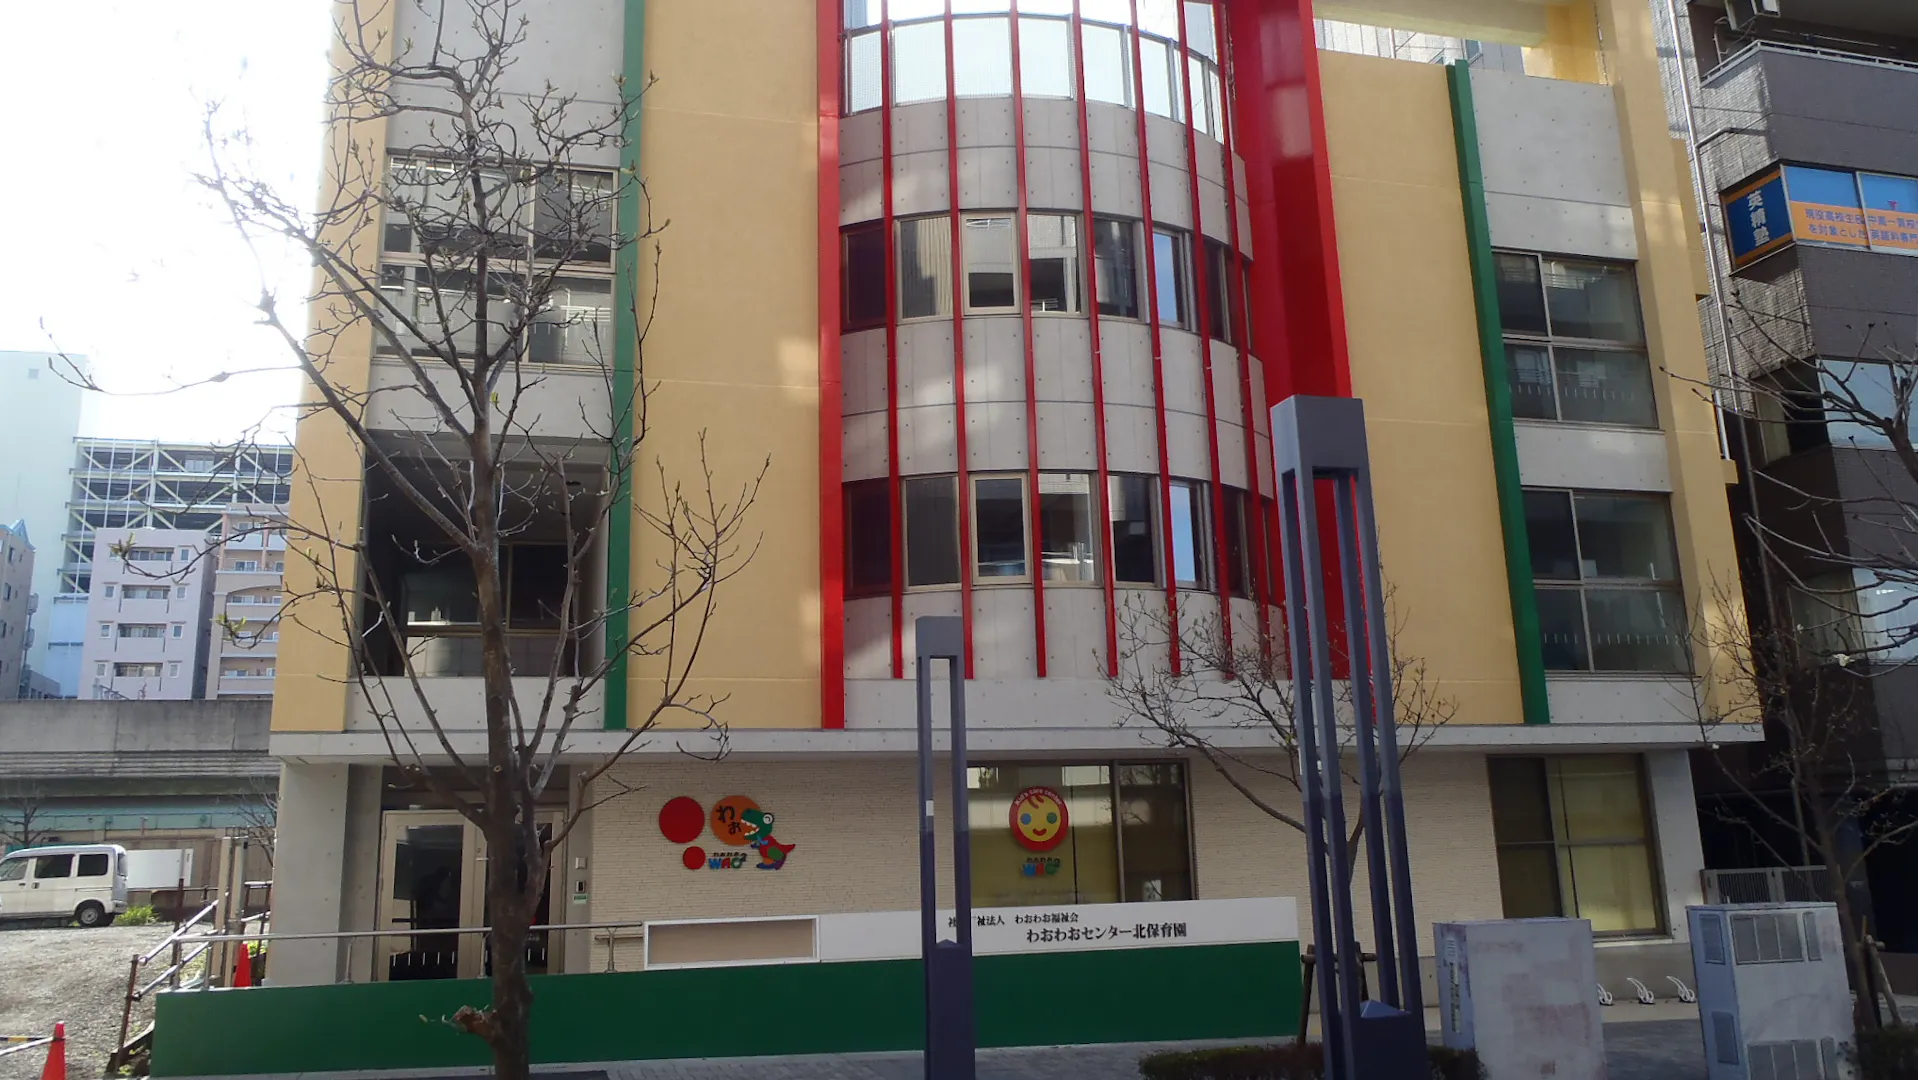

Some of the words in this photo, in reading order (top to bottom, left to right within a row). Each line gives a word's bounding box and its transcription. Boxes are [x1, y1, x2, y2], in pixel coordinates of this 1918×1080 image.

[948, 914, 1006, 928] 社祉法人
[1014, 912, 1079, 925] わおわお福祉会
[1026, 922, 1188, 943] わおわおセンター北保育園
